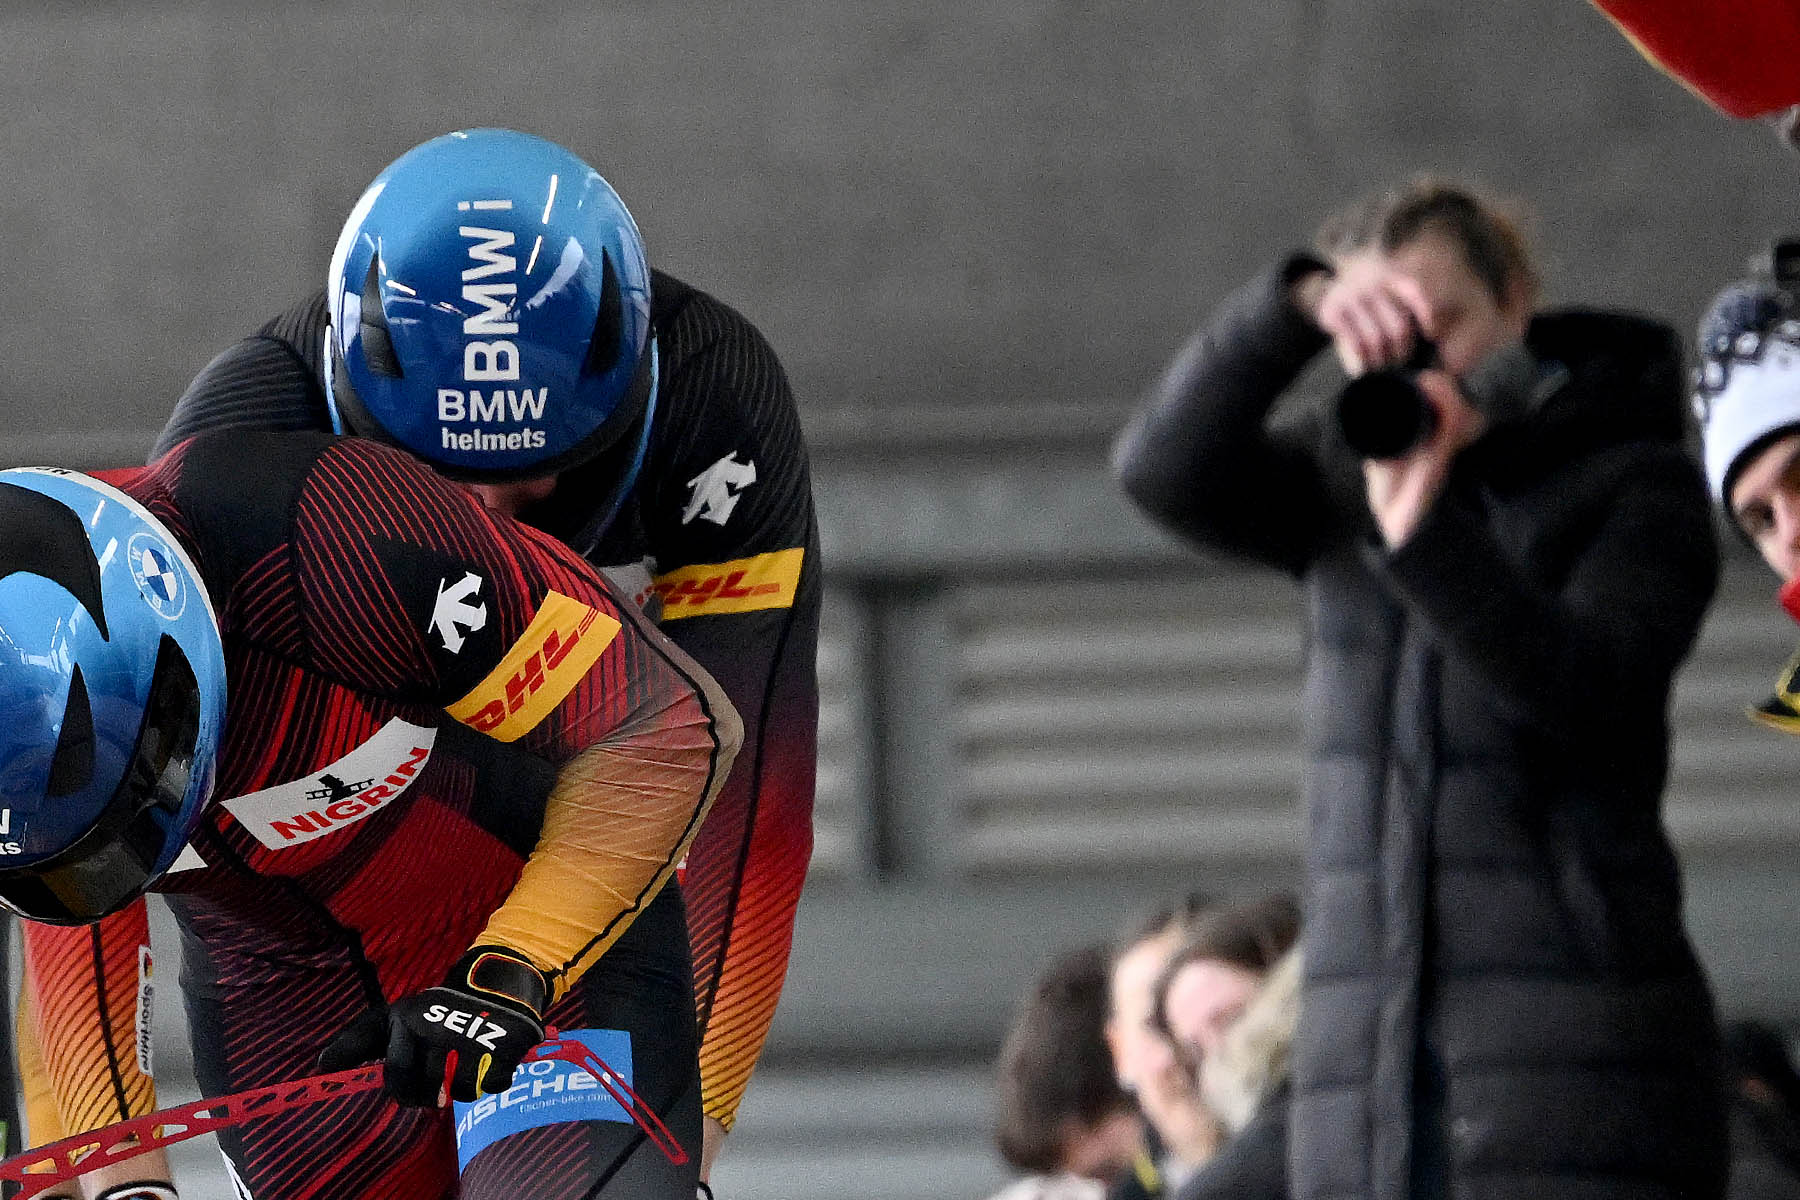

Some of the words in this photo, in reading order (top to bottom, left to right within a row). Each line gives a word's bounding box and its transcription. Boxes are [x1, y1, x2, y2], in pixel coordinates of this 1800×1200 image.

[459, 225, 520, 382] BMW
[437, 387, 548, 422] BMW
[441, 427, 546, 452] helmets
[466, 628, 580, 732] DHL
[270, 747, 428, 840] NIGRIN
